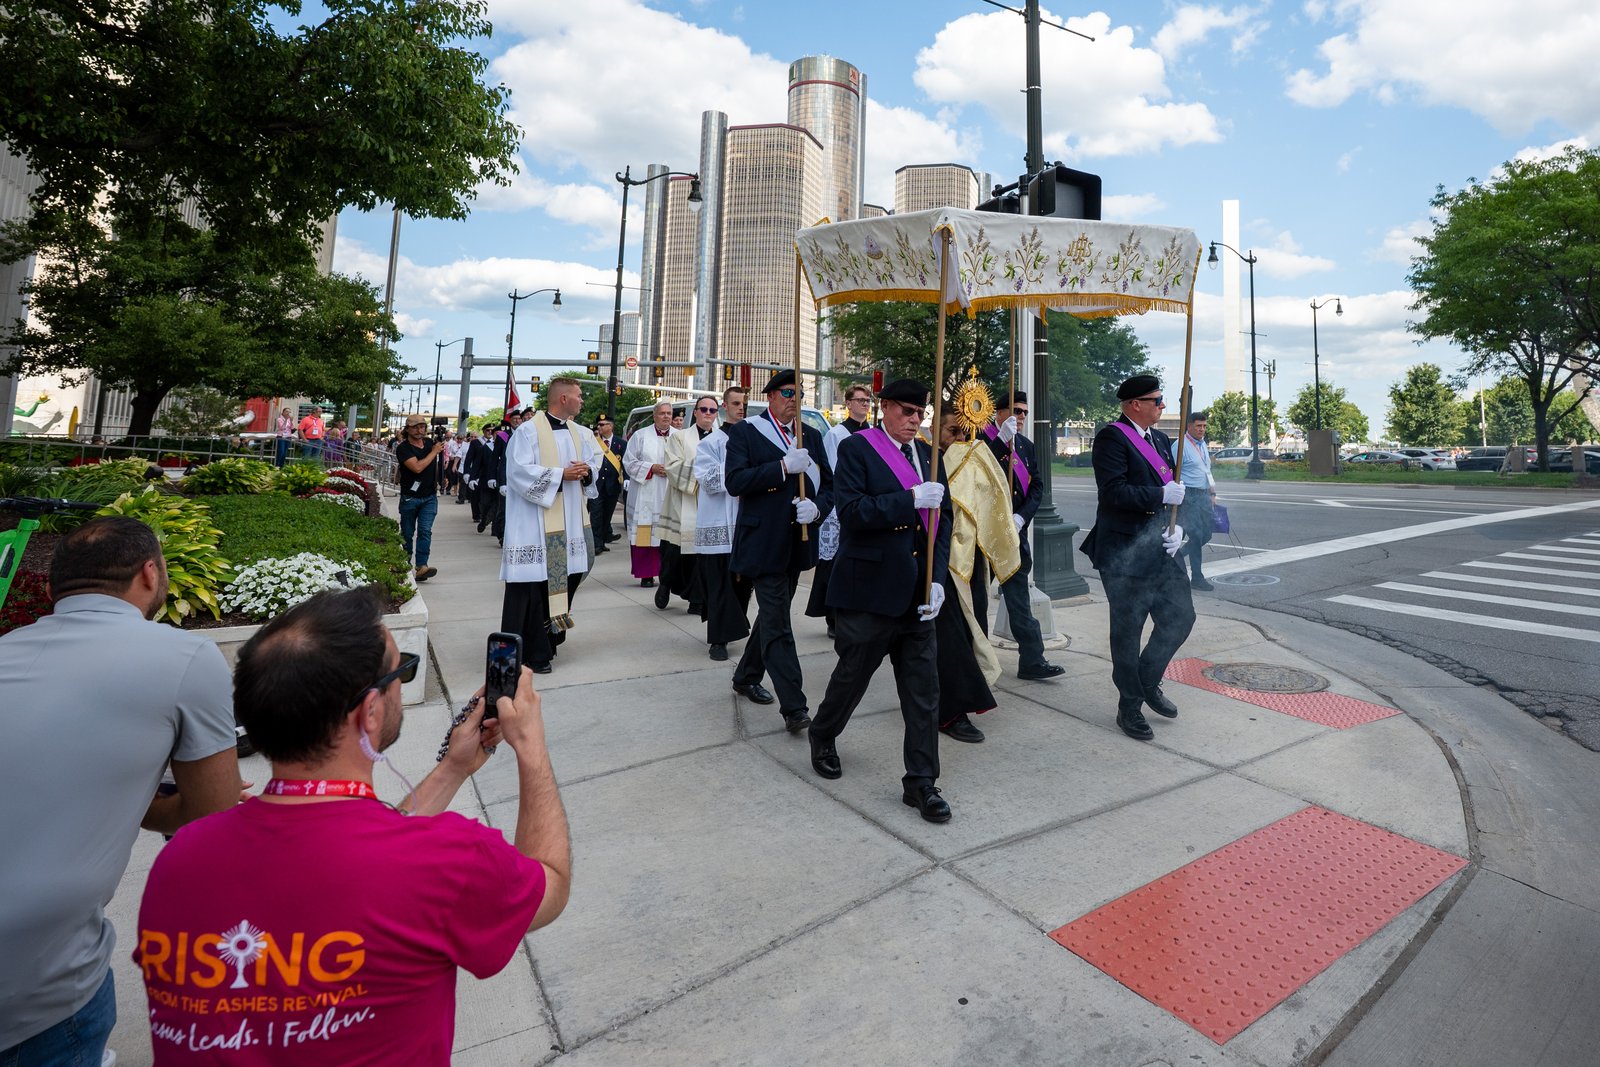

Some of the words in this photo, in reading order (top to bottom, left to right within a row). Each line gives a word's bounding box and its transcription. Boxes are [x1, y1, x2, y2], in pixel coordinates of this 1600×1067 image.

[181, 996, 209, 1015] THE
[214, 996, 278, 1013] ASHES
[283, 983, 368, 1012] REVIVAL
[188, 1018, 260, 1052] Leads.
[267, 1022, 273, 1046] I
[283, 1006, 376, 1047] Follow.
